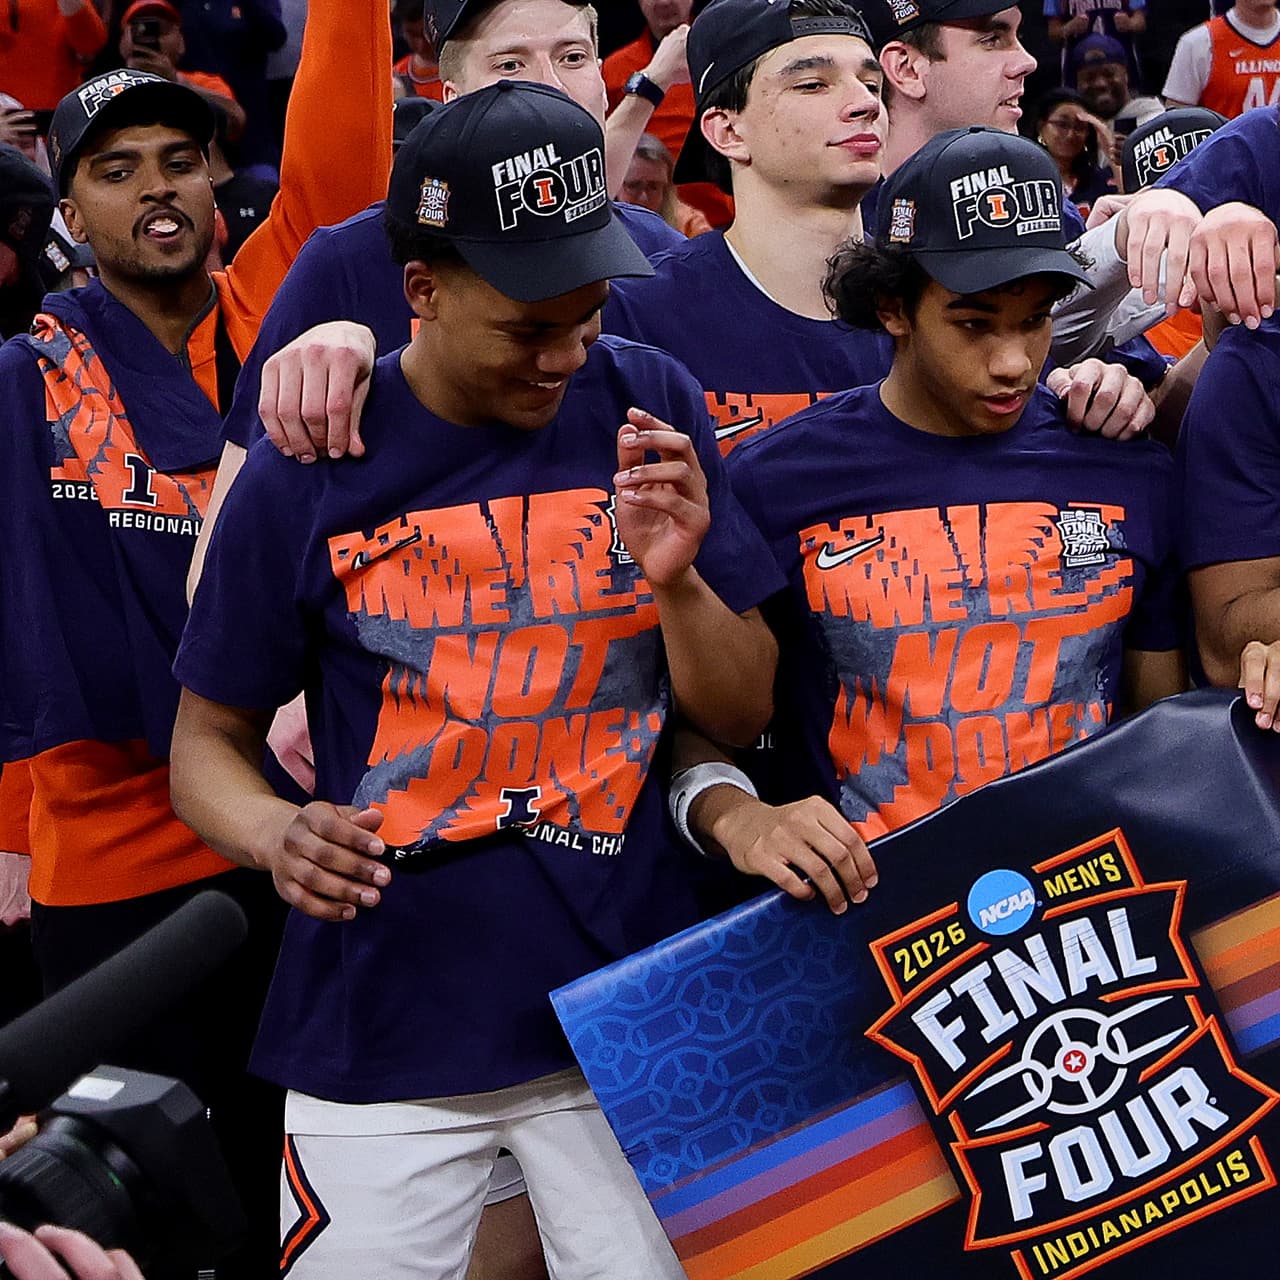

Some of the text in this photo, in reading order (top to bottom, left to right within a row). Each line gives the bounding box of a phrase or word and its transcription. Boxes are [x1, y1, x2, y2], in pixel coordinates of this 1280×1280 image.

[895, 4, 915, 20] FOUR
[78, 72, 134, 100] FINAL
[1133, 126, 1174, 157] FINAL
[491, 143, 561, 187] FINAL
[950, 165, 1014, 200] FINAL
[420, 207, 444, 221] FOUR
[422, 187, 447, 202] FINAL
[1063, 521, 1101, 536] FINAL
[428, 619, 625, 720] NOT
[888, 615, 1065, 716] NOT
[1044, 852, 1123, 899] MEN'S
[978, 887, 1036, 928] NCAA
[895, 923, 967, 982] 2026
[911, 907, 1158, 1073] FINAL
[1000, 1066, 1229, 1223] FOUR
[1032, 1150, 1251, 1275] INDIANAPOLIS
